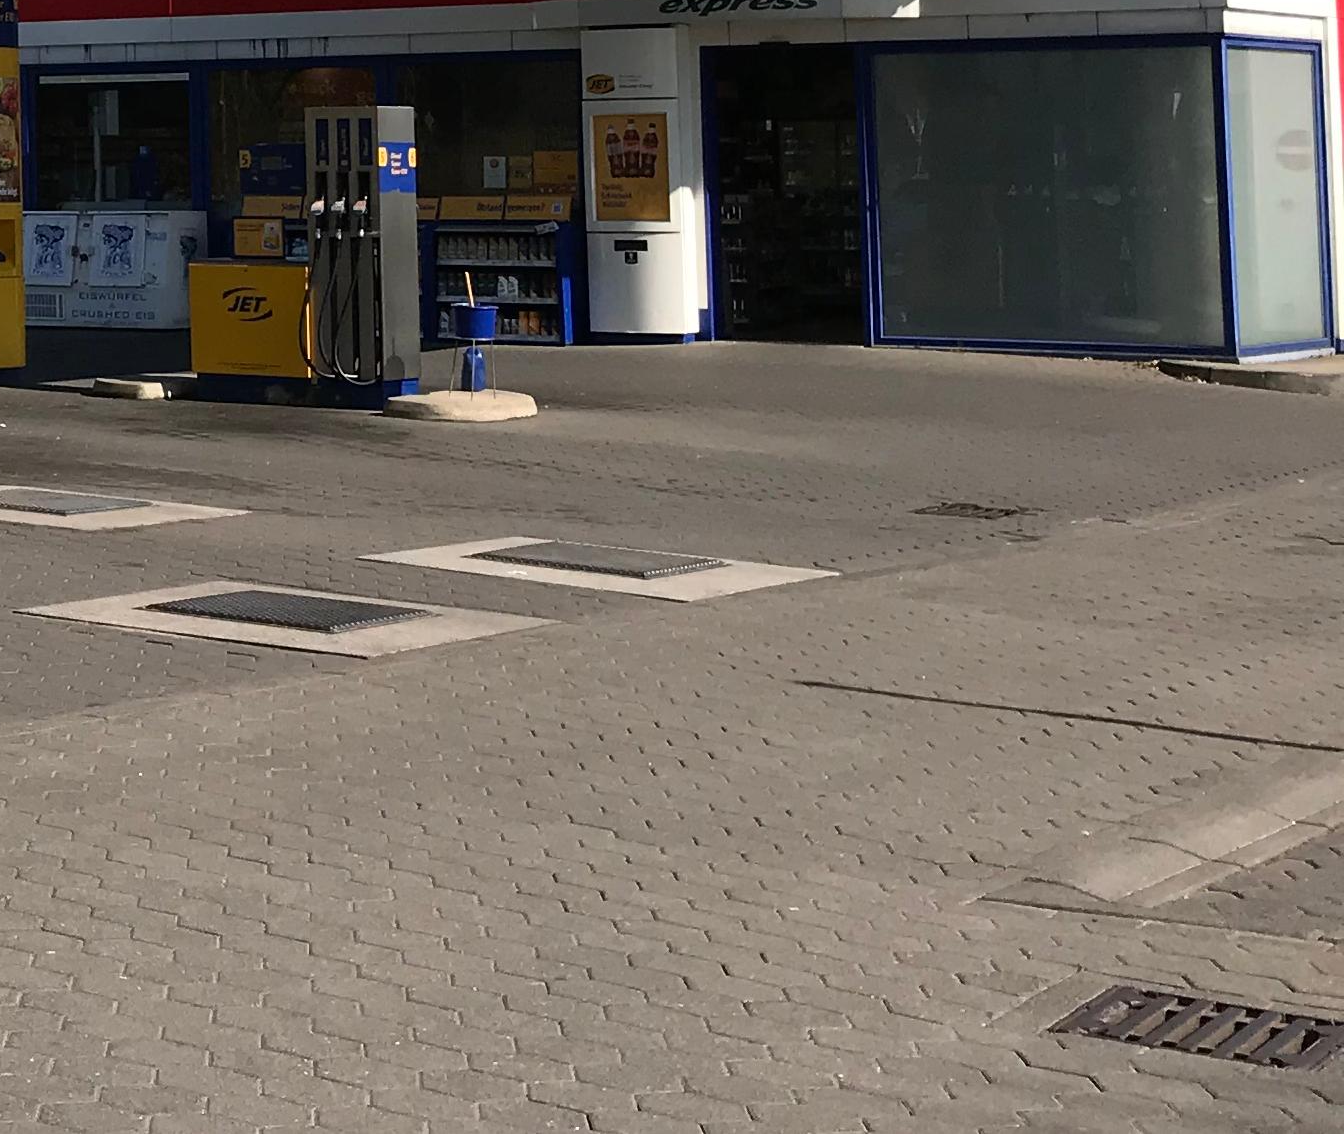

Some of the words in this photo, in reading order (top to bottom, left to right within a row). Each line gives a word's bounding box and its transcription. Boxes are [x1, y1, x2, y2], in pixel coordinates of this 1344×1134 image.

[241, 154, 248, 165] 5
[227, 296, 267, 313] JET
[71, 309, 130, 319] CRUSHED
[135, 310, 156, 320] EIS
